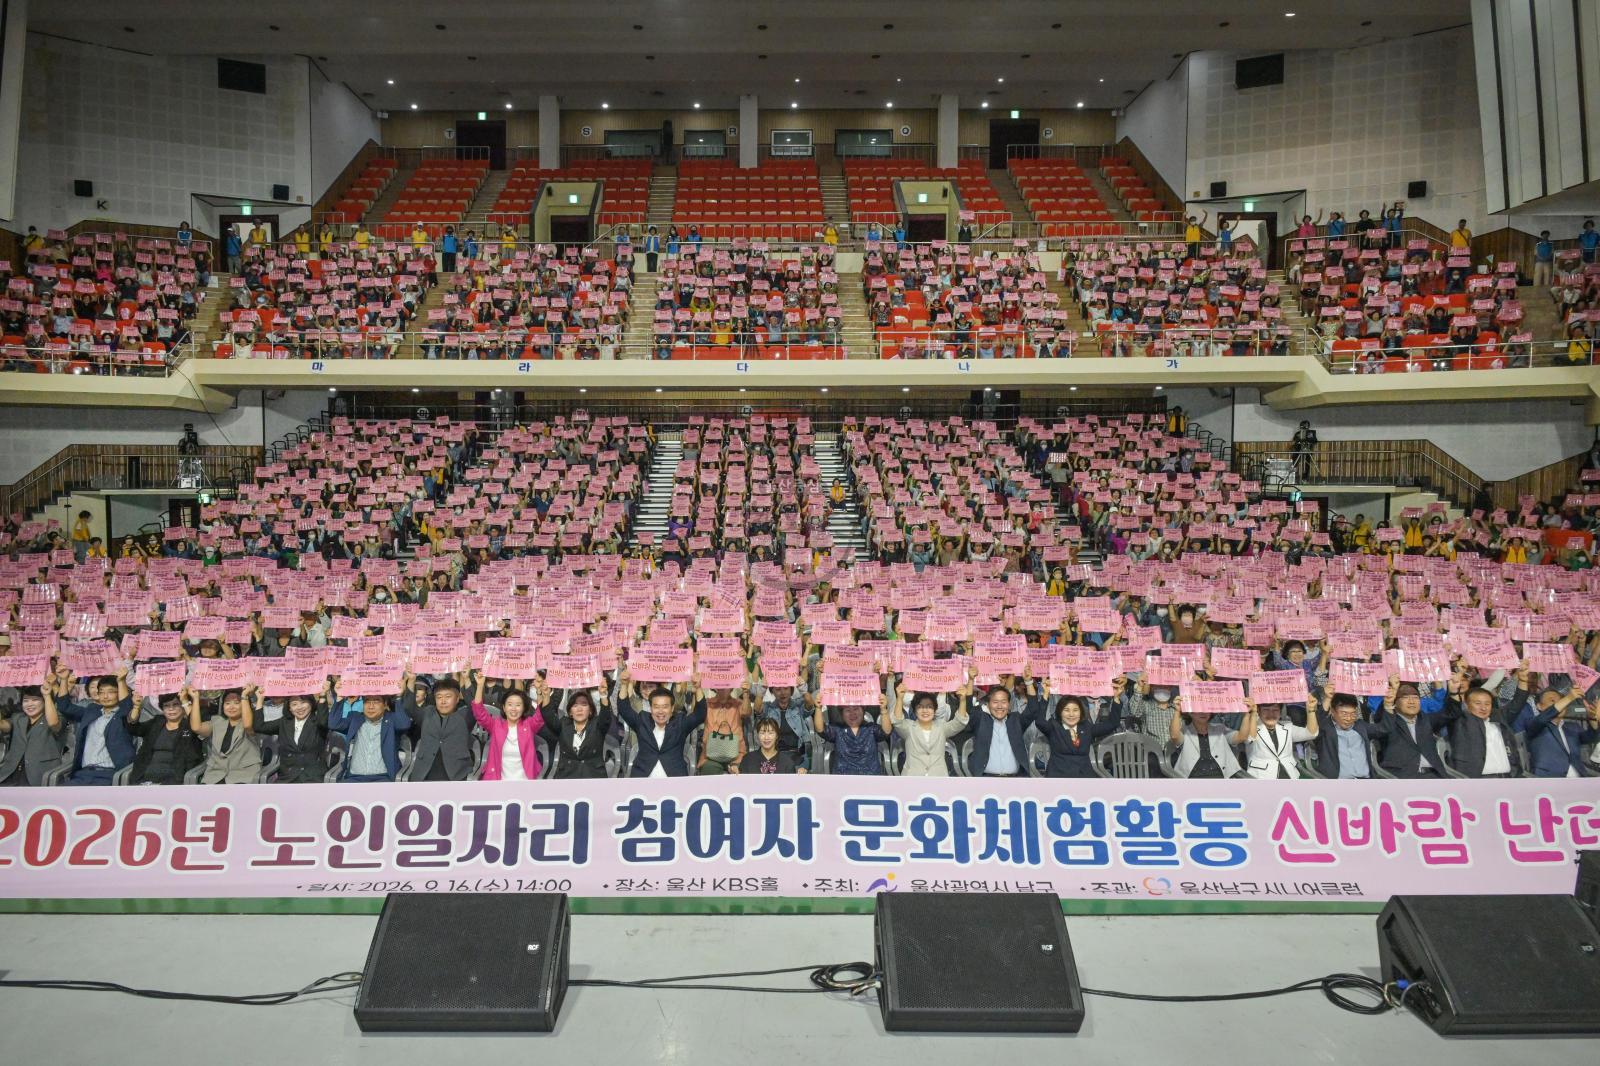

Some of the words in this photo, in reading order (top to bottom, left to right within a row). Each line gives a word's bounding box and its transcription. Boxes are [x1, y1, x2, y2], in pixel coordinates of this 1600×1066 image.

[582, 127, 590, 136] S
[729, 127, 737, 135] R
[1044, 129, 1052, 137] P
[97, 200, 107, 210] K
[312, 361, 325, 371] 마
[519, 362, 531, 372] 라
[737, 362, 749, 372] 다
[959, 361, 970, 371] 나
[1167, 359, 1179, 369] 가
[672, 665, 686, 673] DAY
[251, 801, 590, 869] 노인일자리
[614, 796, 820, 862] 참여자
[840, 797, 1248, 867] 문화체험활동
[1271, 797, 1476, 865] 신바람
[361, 881, 416, 892] 2026.
[516, 879, 572, 892] 14:00
[615, 878, 660, 892] 장소:
[666, 877, 706, 892] 울산
[712, 876, 779, 892] KBS홀
[814, 878, 860, 892] 주최:
[910, 879, 1008, 893] 울산광역시
[1091, 882, 1136, 894] 주관:
